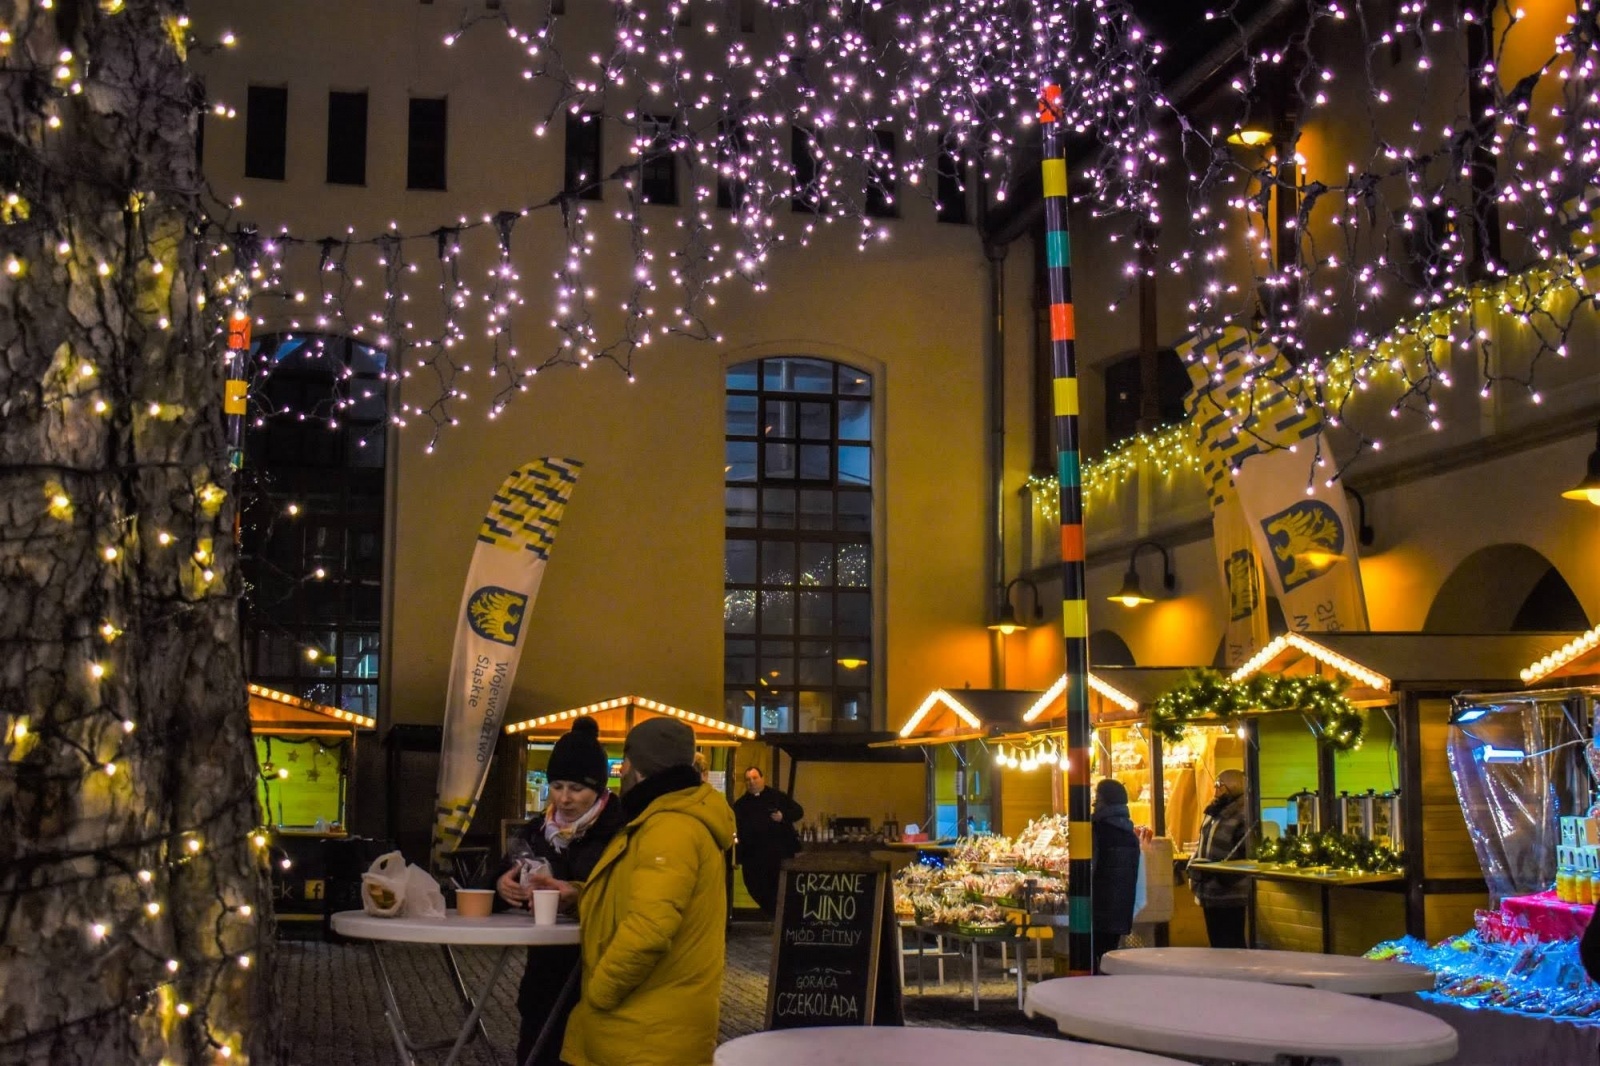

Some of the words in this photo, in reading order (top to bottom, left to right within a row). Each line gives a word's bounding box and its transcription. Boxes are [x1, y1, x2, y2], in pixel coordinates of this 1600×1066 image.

[796, 873, 867, 895] GRZANE
[803, 895, 856, 920] WINO
[786, 926, 815, 942] MIÓD
[822, 928, 862, 946] PITNY
[777, 992, 858, 1018] CZEKOLADA
